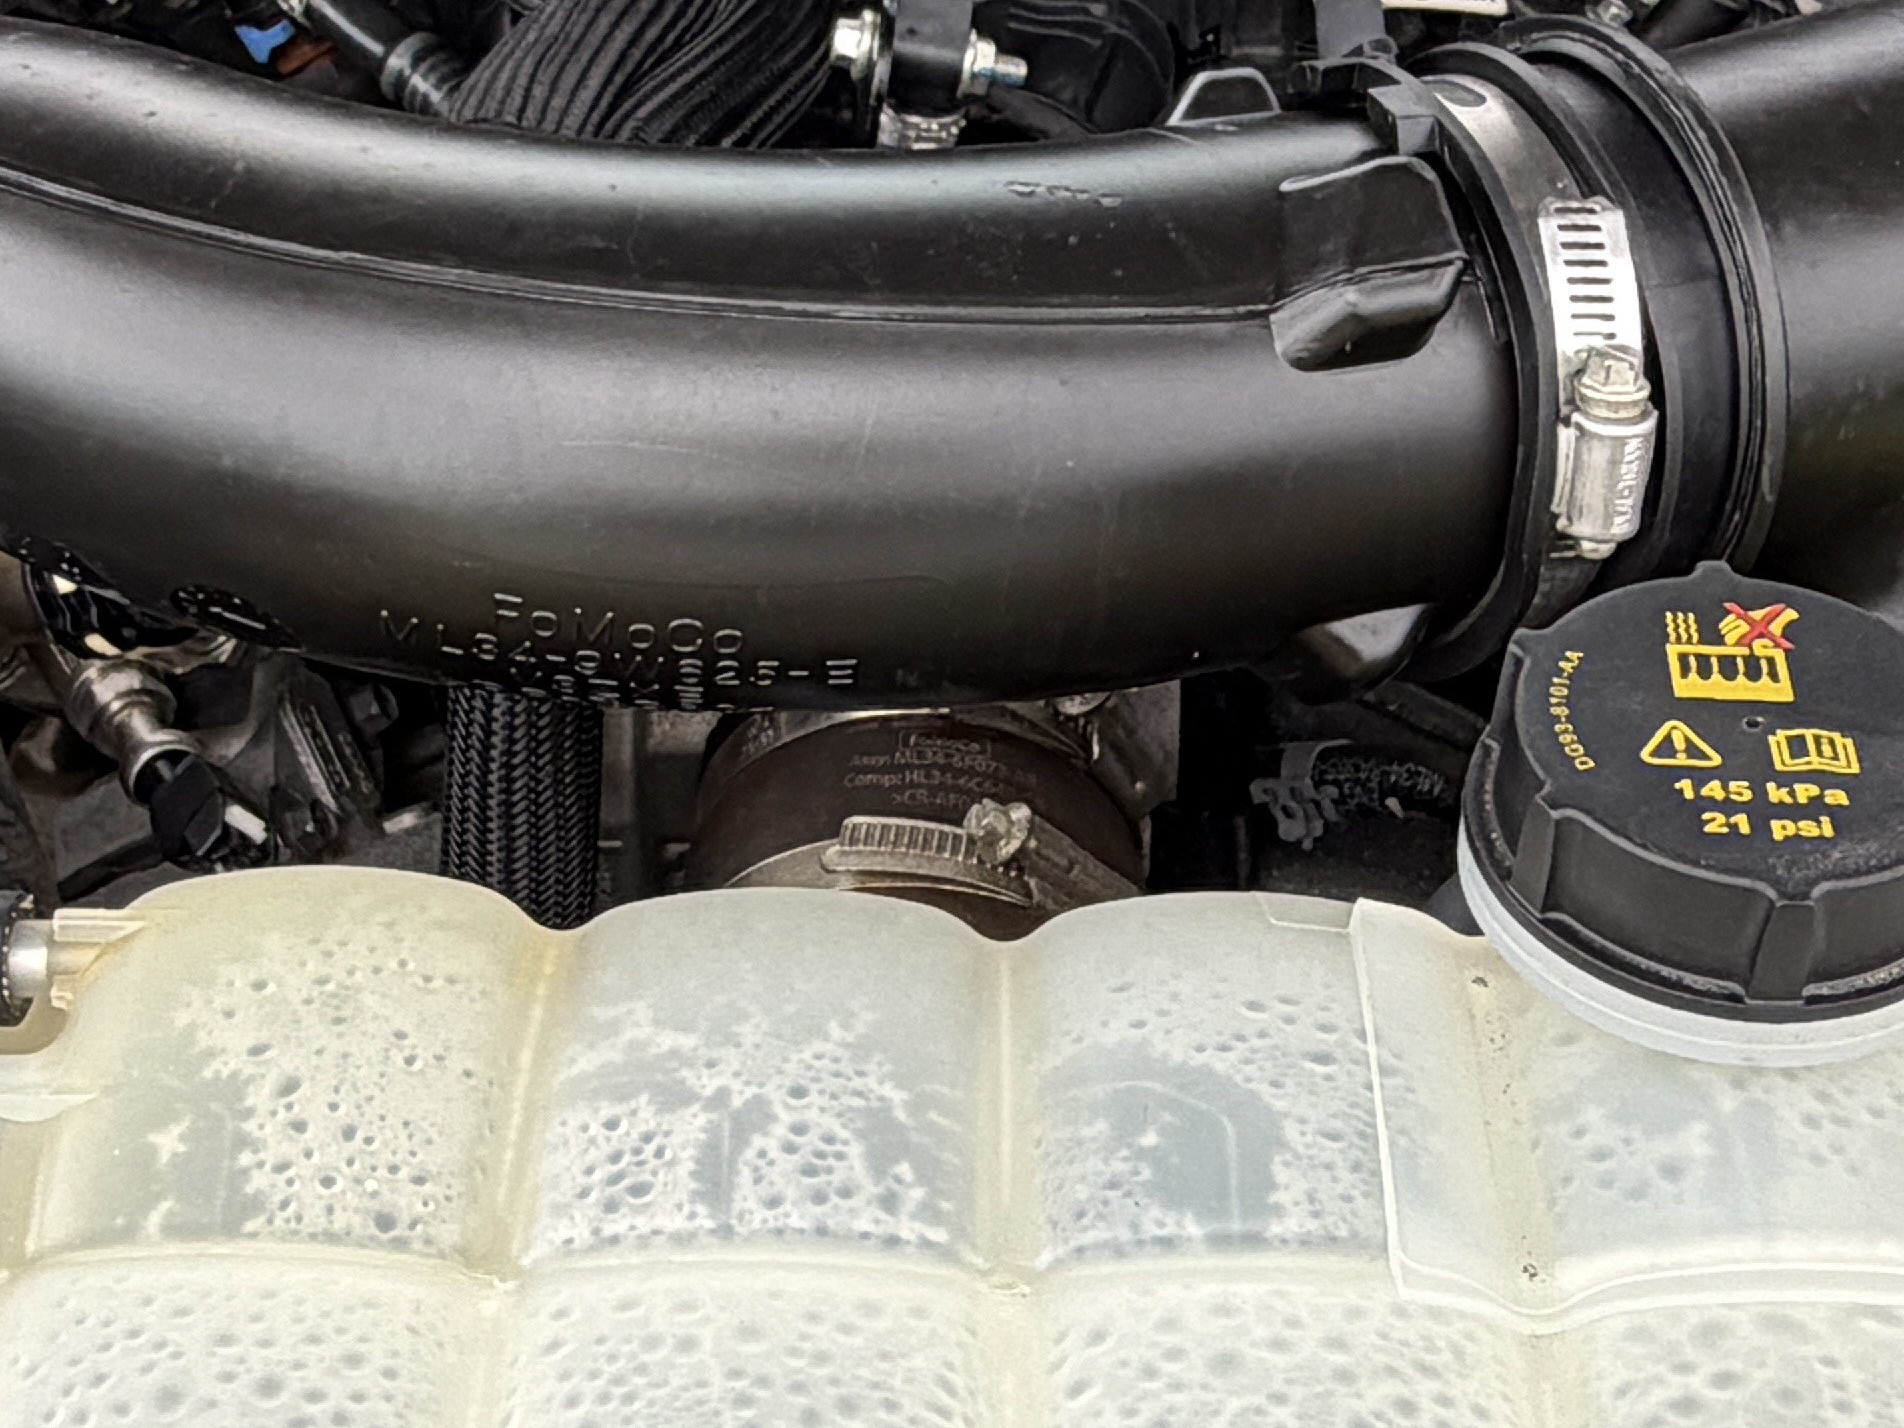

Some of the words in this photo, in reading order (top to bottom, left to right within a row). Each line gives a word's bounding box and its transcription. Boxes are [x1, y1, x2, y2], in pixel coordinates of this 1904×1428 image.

[495, 592, 743, 655] FoMoCo
[1674, 778, 1753, 803] 145
[1766, 781, 1850, 806] kPa
[1701, 812, 1752, 835] 21
[1770, 816, 1835, 841] psi
